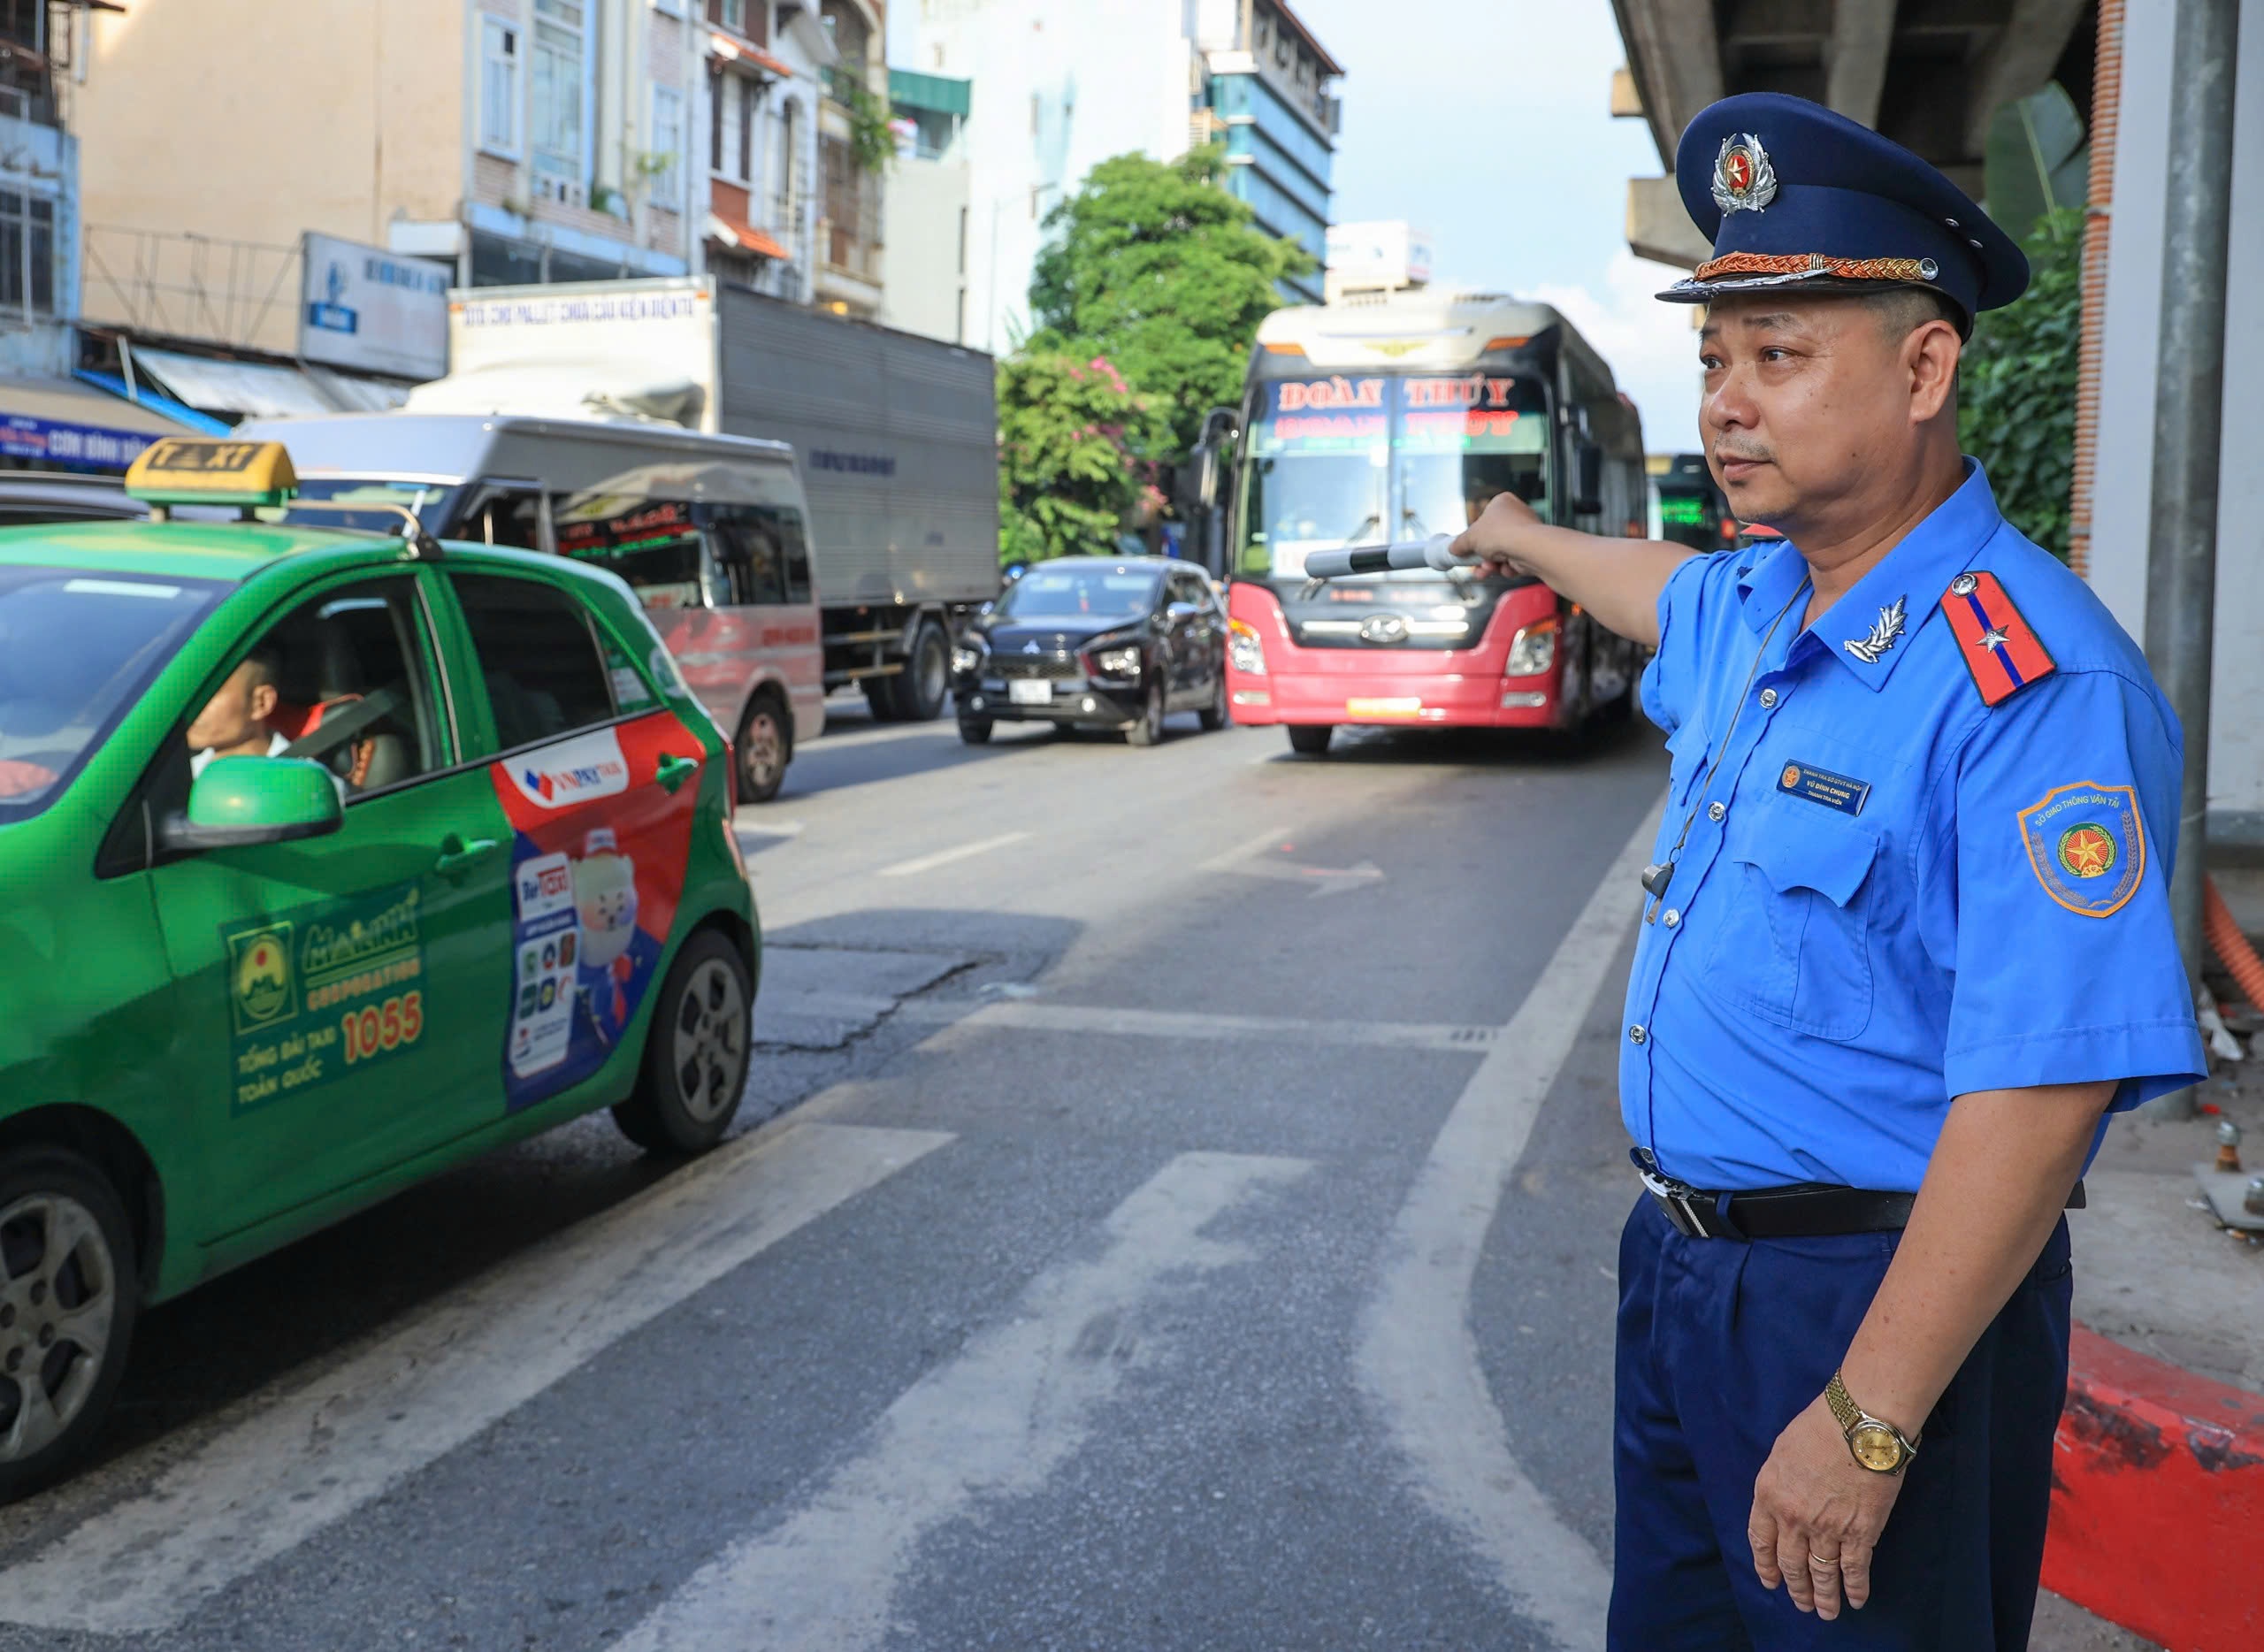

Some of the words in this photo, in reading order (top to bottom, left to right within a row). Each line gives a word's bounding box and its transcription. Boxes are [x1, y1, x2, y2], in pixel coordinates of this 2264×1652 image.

[155, 443, 256, 469] TAXI
[1808, 790, 1823, 799] THANH
[1832, 797, 1843, 806] VIÊN
[1830, 787, 1850, 799] CHUNG
[2035, 813, 2046, 827] SỞ
[2045, 804, 2062, 819] GIAO
[2061, 795, 2089, 808] THÔNG
[2090, 793, 2107, 806] VẬN
[2107, 797, 2120, 808] TẢI
[307, 956, 421, 1012] CORPORATION
[341, 990, 424, 1065] 1055
[238, 1044, 278, 1075] TỔNG
[307, 1026, 336, 1047] TAXI
[238, 1074, 279, 1104] TOÀN
[281, 1055, 324, 1089] QUỐC
